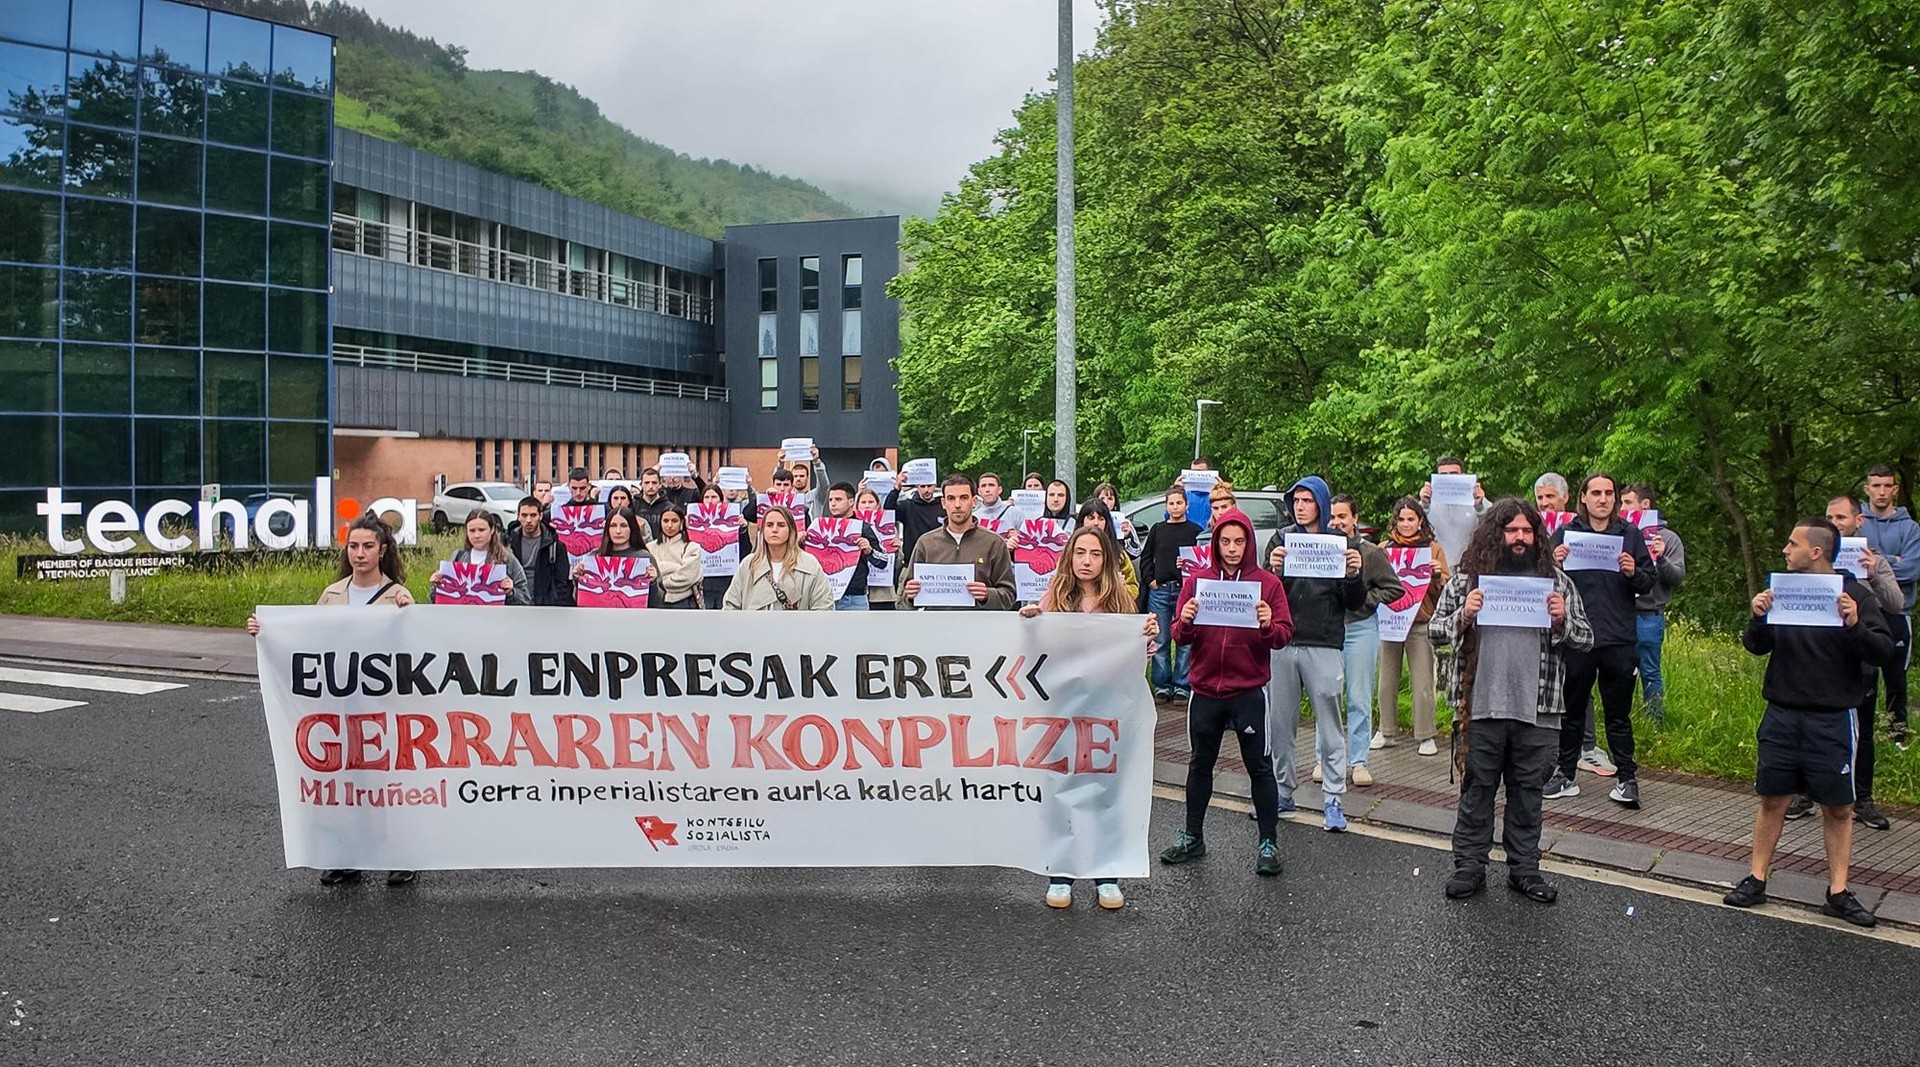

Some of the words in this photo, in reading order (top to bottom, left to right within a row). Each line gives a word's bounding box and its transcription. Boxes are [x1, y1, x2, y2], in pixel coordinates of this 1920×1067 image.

[562, 505, 594, 521] M1
[698, 502, 729, 519] M1
[818, 517, 850, 537] M1
[1025, 518, 1054, 536] M1
[36, 560, 77, 570] MEMBER
[79, 559, 92, 568] OF
[95, 558, 134, 567] BASQUE
[136, 556, 184, 566] RESEARCH
[453, 560, 493, 583] M1
[595, 556, 637, 577] M1
[46, 569, 110, 580] TECHNOLOGY
[291, 651, 518, 697] EUSKAL
[528, 651, 839, 700] ENPRESAK
[856, 653, 973, 700] ERE
[295, 710, 711, 772] GERRAREN
[729, 713, 1119, 775] KONPLIZE
[300, 776, 339, 806] M1
[458, 779, 542, 804] Gerra
[550, 779, 758, 805] inperialistaren
[768, 780, 851, 801] aurka
[859, 778, 953, 802] kaleak
[961, 777, 1042, 803] hartu
[686, 818, 765, 828] KONTSEILU
[686, 830, 770, 841] SOZIALISTA
